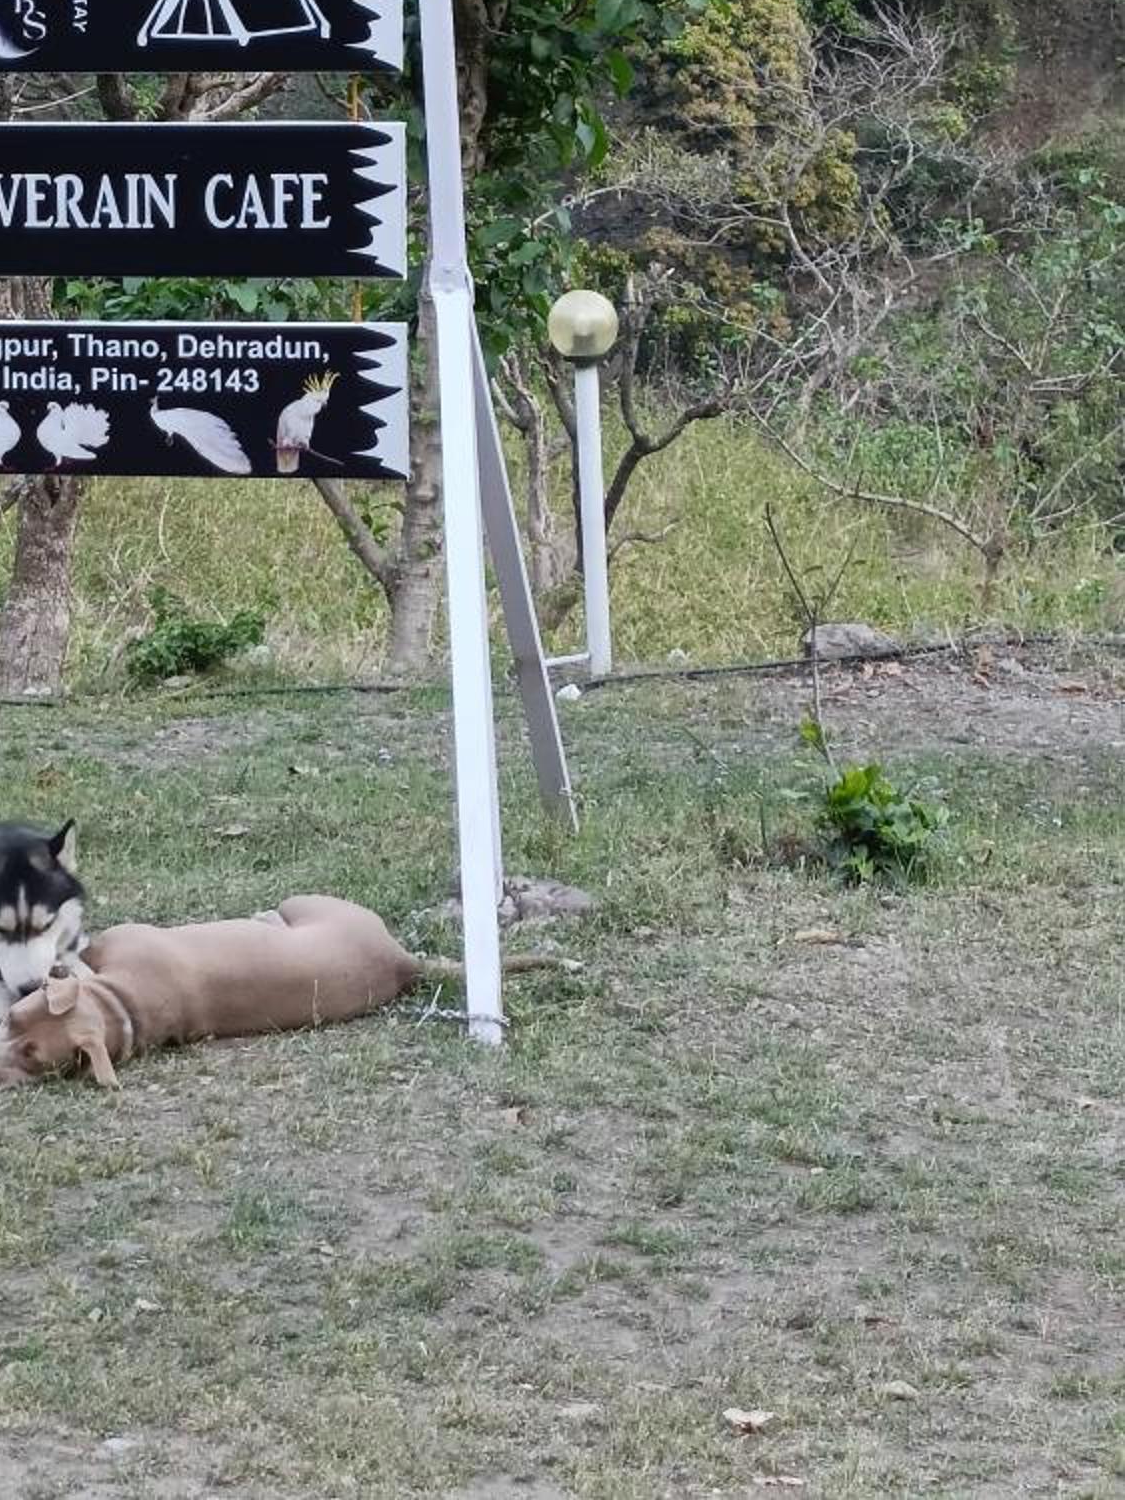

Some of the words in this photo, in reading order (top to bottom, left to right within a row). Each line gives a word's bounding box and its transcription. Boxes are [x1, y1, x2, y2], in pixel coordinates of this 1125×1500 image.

[204, 173, 332, 229] CAFE
[67, 333, 167, 362] Thano,
[178, 334, 329, 363] Dehradun,
[3, 365, 81, 395] India,
[91, 367, 149, 391] Pin-
[156, 367, 260, 393] 248143
